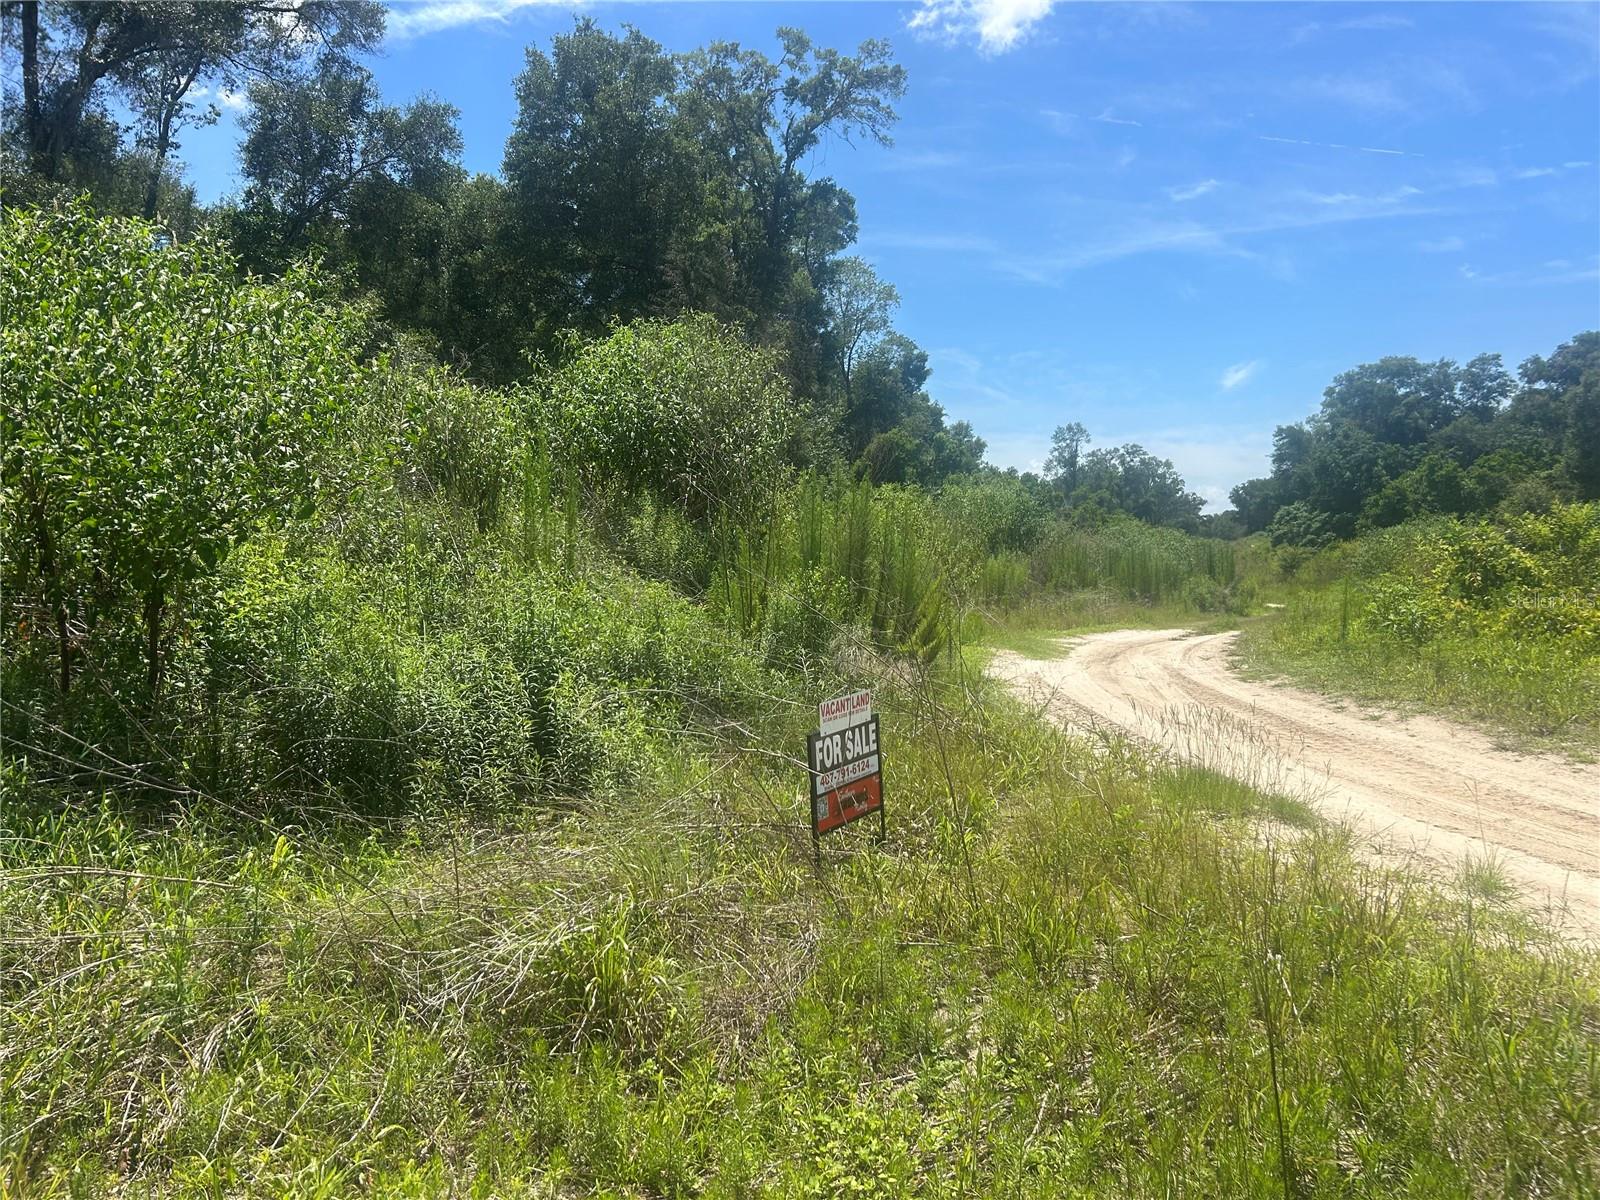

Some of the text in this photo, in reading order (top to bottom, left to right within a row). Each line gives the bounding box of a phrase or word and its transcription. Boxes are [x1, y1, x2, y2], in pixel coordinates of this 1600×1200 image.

[820, 692, 870, 717] VACANT LAND
[815, 722, 878, 771] FOR SALE
[820, 759, 870, 786] 407-791-6124
